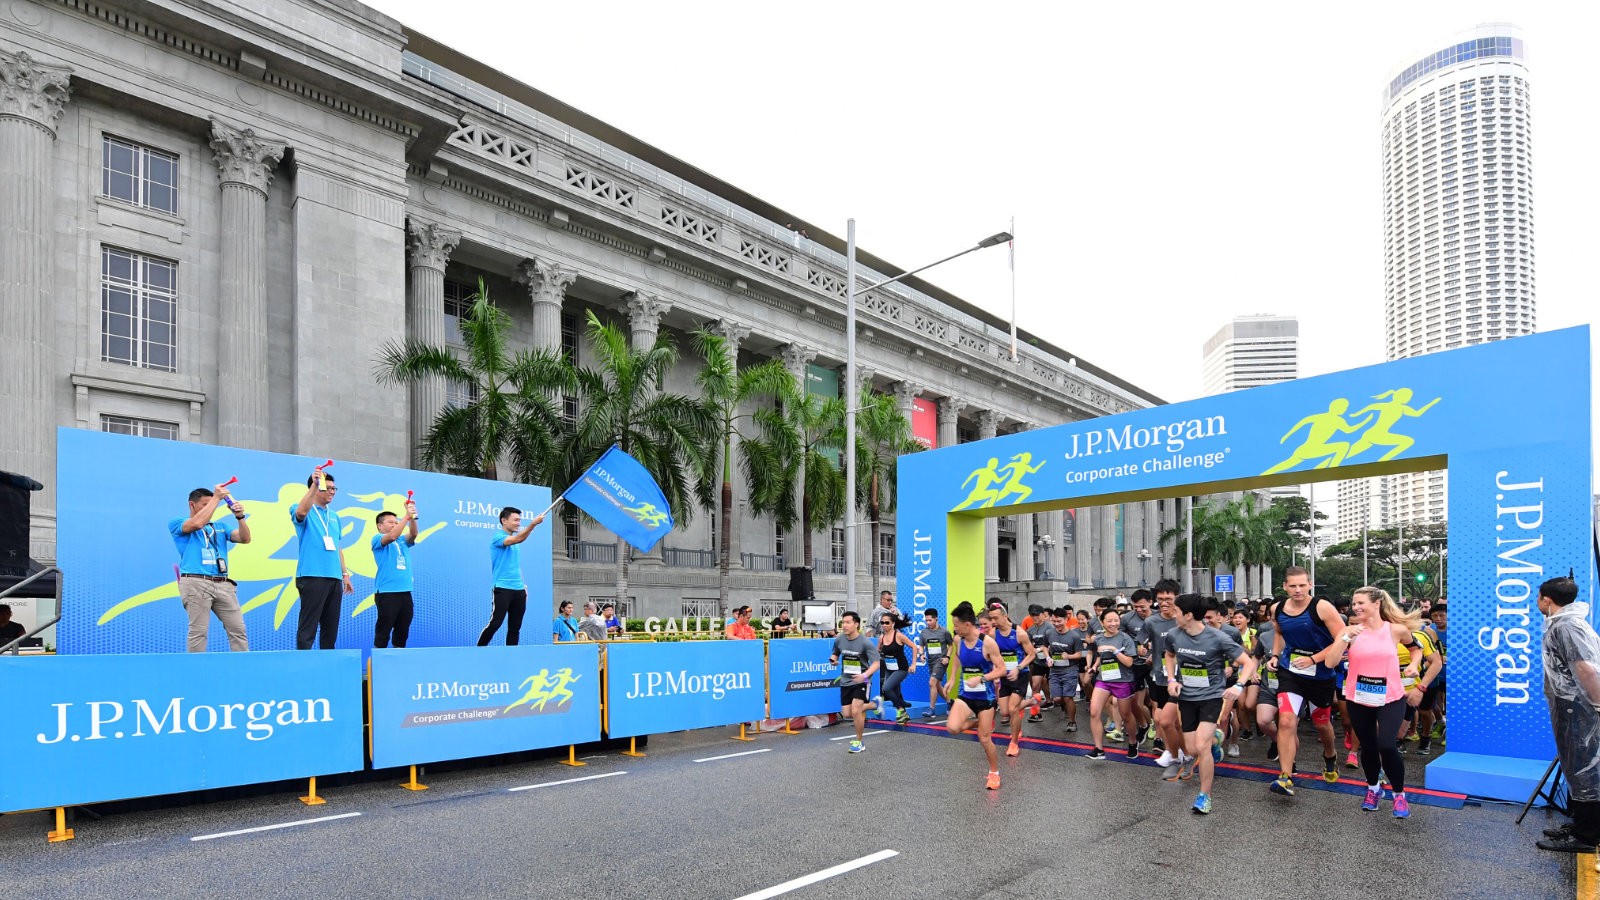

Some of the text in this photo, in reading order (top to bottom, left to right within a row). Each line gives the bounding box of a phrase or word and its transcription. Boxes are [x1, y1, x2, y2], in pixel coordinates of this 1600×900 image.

[1065, 415, 1227, 459] J.P.Morgan
[593, 467, 636, 502] J.P.Morgan
[1066, 463, 1138, 483] Corporate
[455, 519, 496, 530] Corporate
[1478, 470, 1543, 706] J.P.Morgan
[412, 681, 510, 700] J.P.Morgan
[626, 670, 751, 700] J.P.Morgan
[1359, 683, 1384, 693] 12850
[37, 697, 334, 744] J.P.Morgan
[413, 712, 456, 724] Corporate
